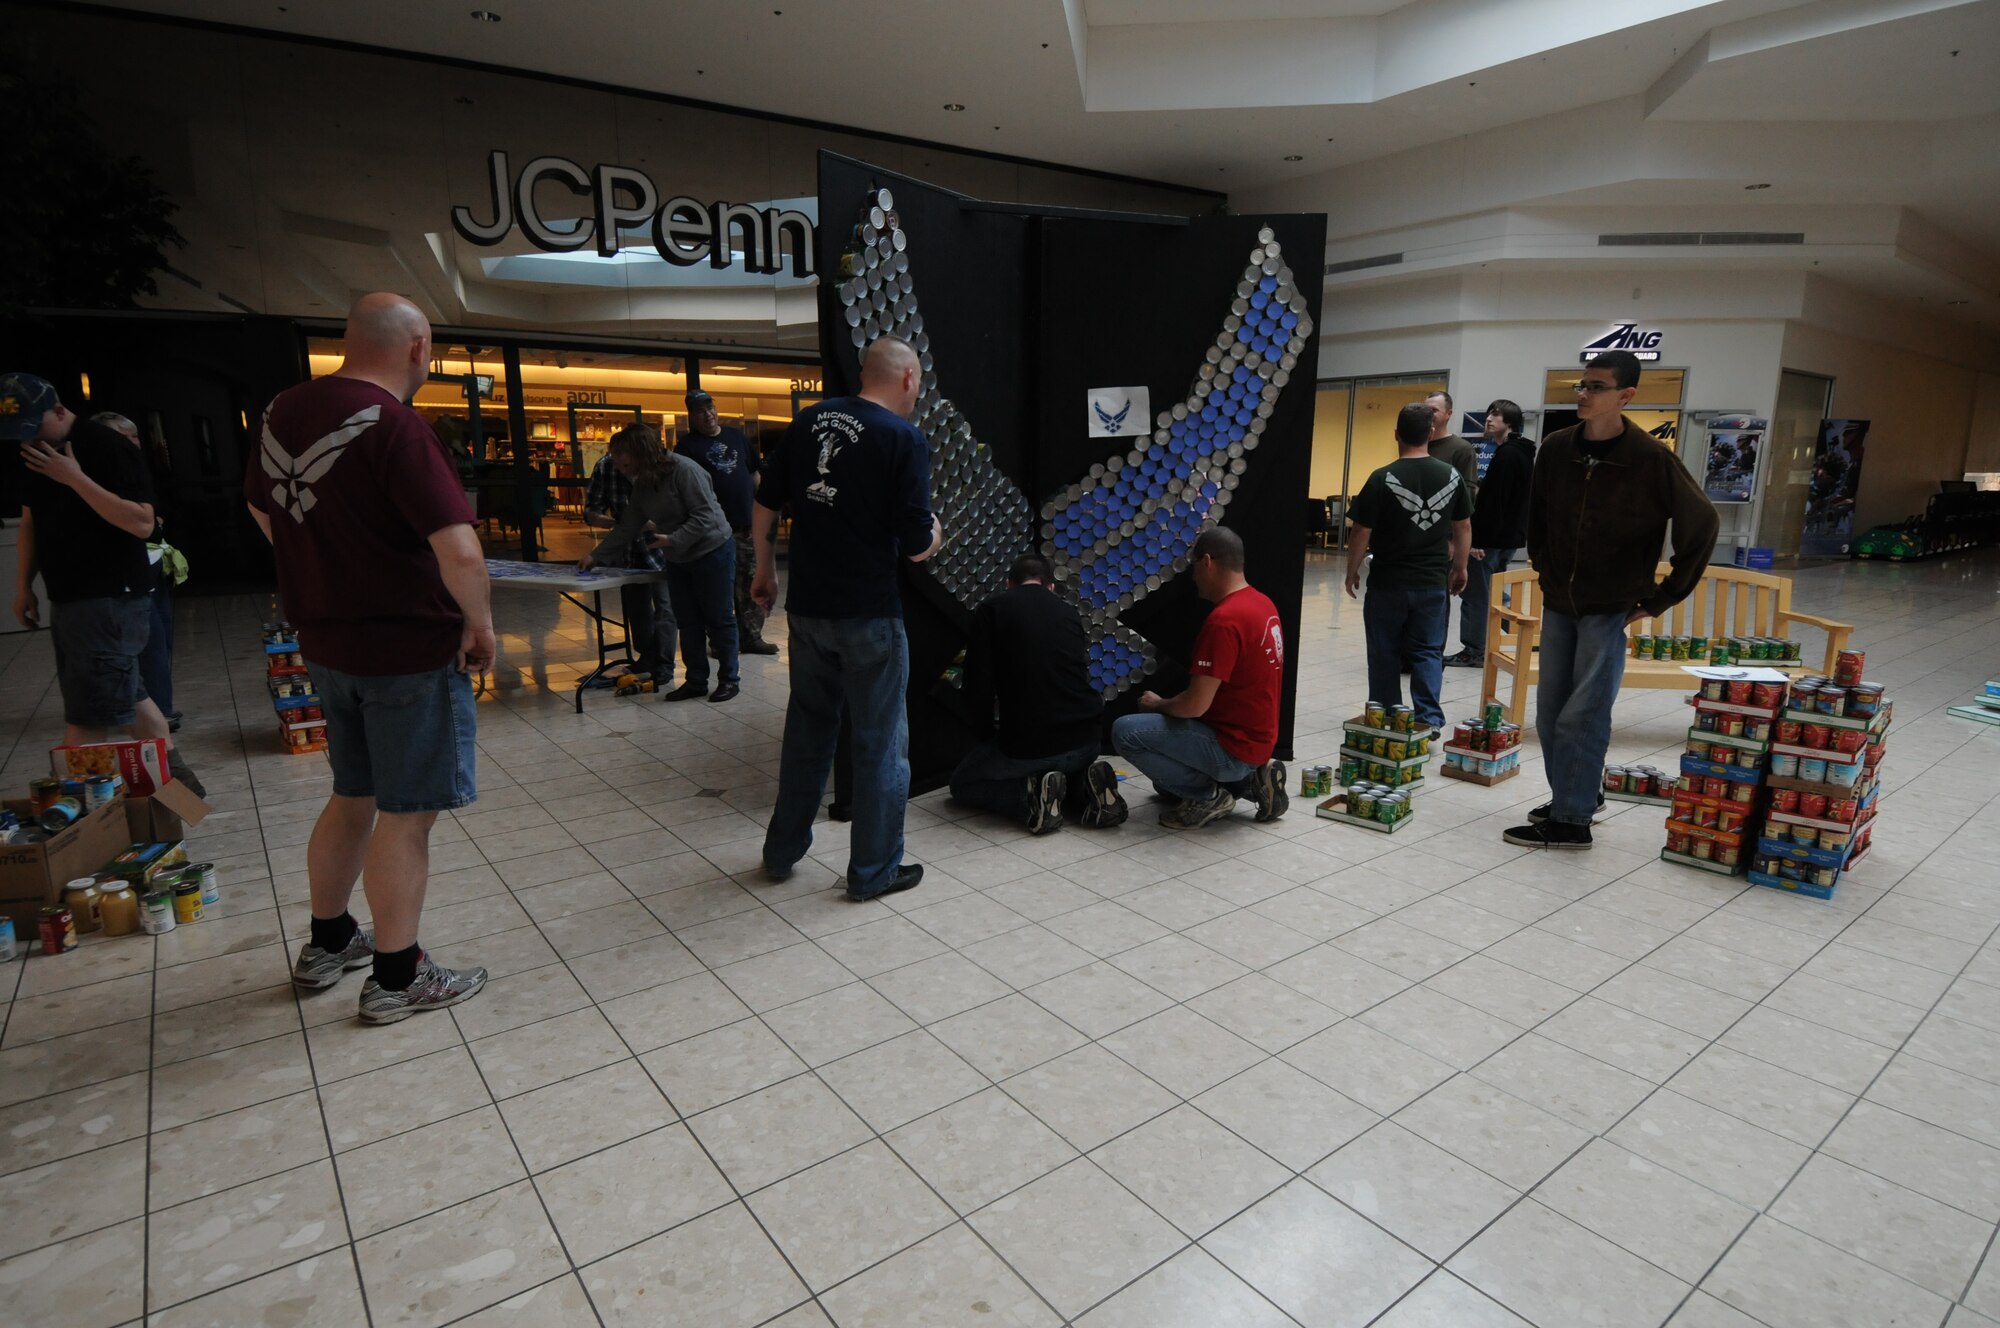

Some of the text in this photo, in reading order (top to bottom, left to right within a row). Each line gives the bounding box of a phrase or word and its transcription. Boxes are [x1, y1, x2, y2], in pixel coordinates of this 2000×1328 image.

[452, 149, 816, 279] JCPenn
[1584, 323, 1663, 349] ANG
[790, 379, 824, 391] apr
[567, 390, 608, 404] april
[811, 419, 859, 444] AIR GUARD
[817, 411, 865, 432] MICHIGAN
[1649, 420, 1676, 439] AN
